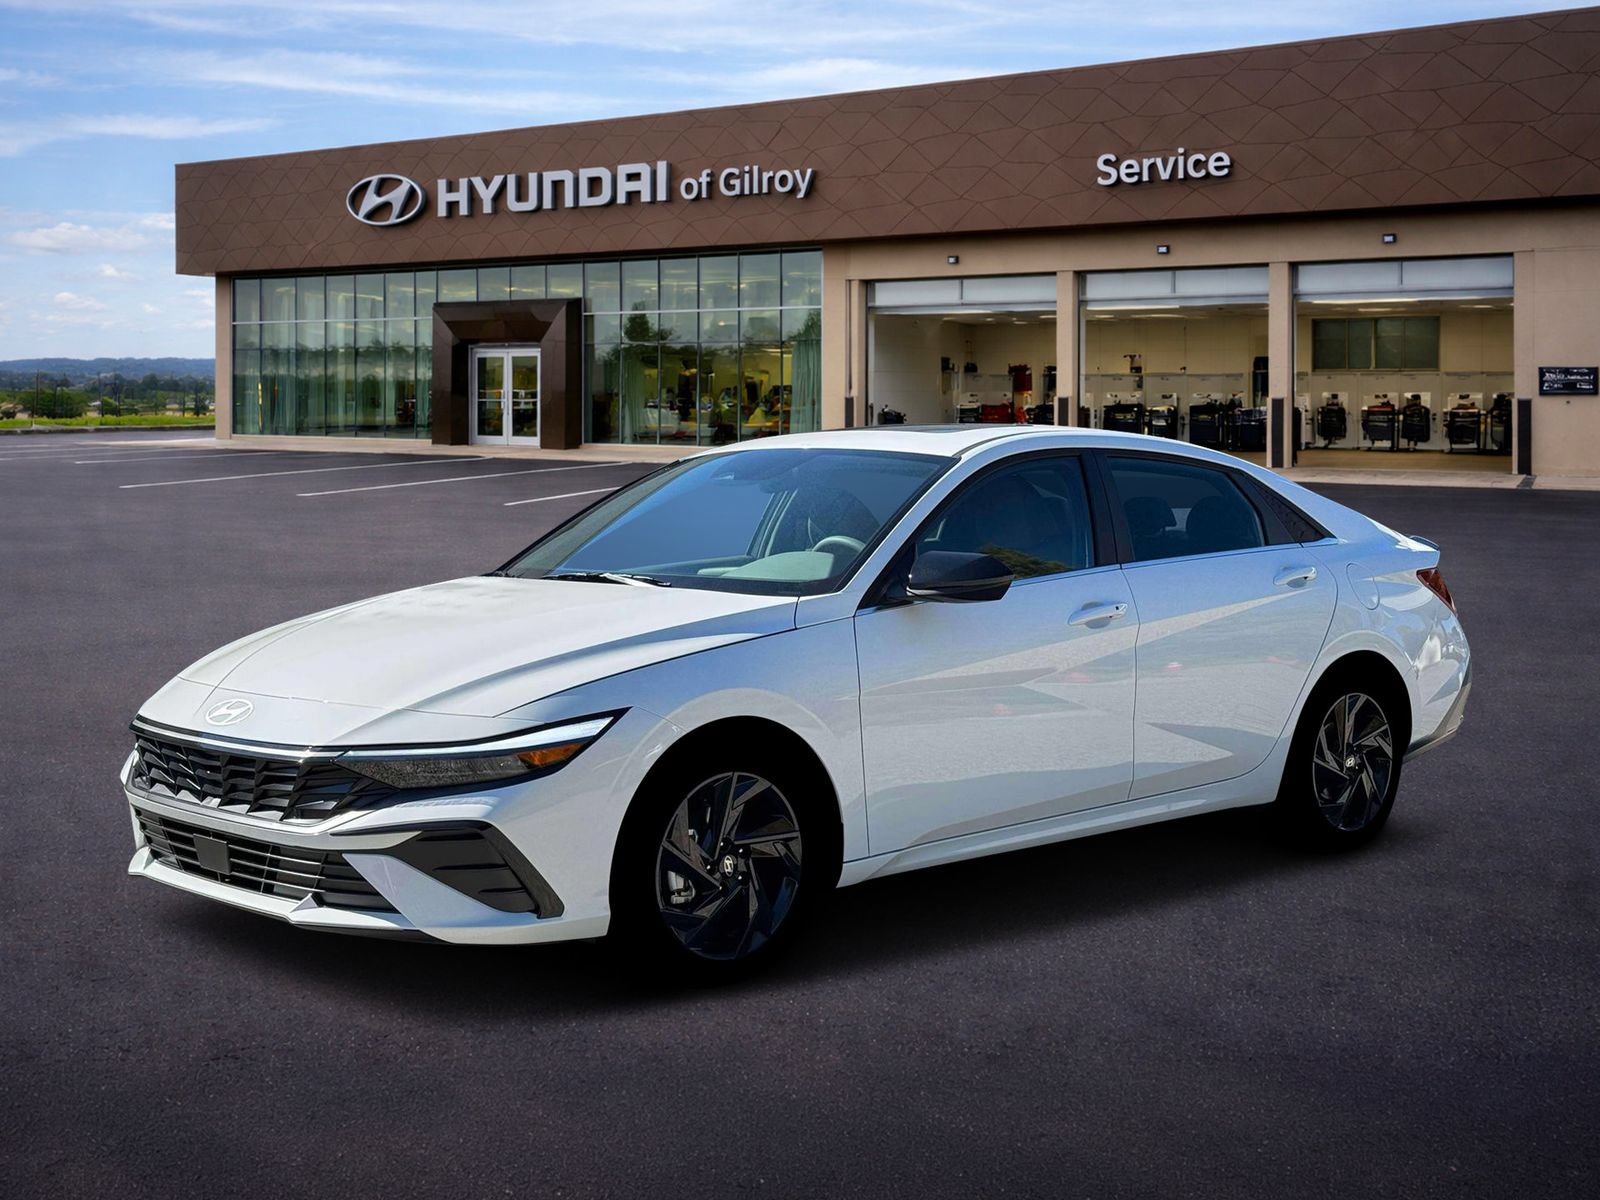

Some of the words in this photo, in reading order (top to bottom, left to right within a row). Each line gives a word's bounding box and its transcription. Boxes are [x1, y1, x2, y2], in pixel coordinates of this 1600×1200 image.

[436, 160, 669, 217] HYUNDAI
[679, 169, 711, 200] of
[718, 165, 813, 199] Gilroy
[1096, 147, 1231, 186] Service
